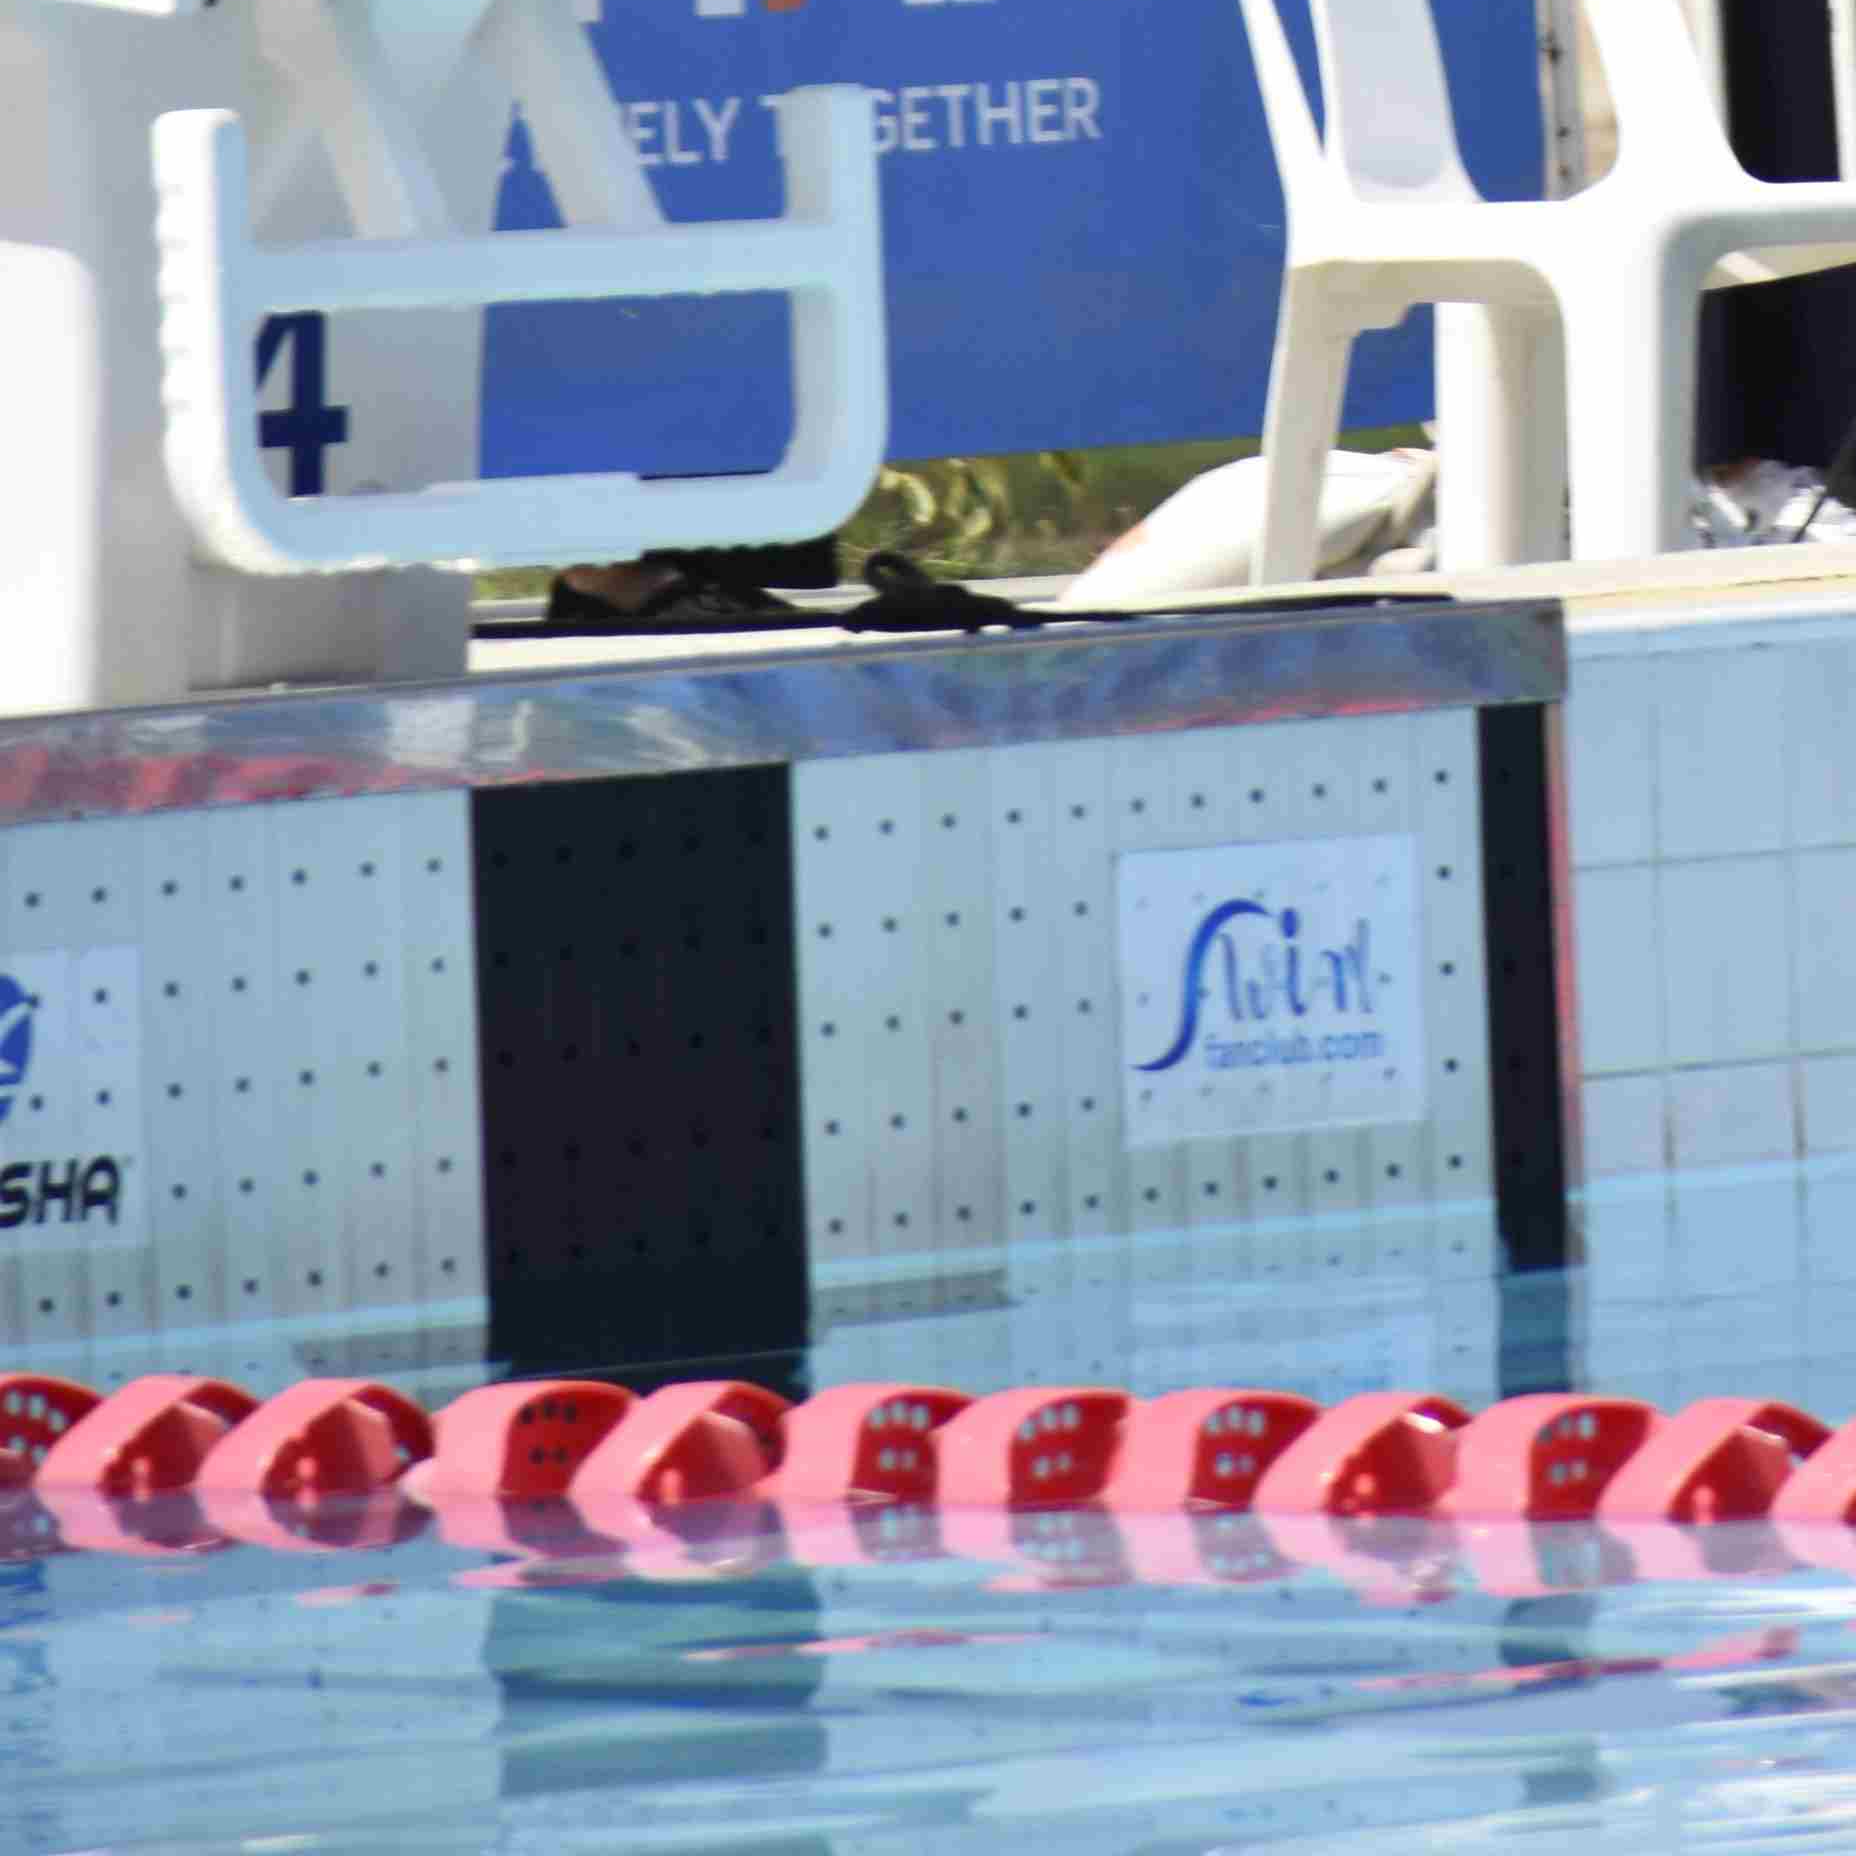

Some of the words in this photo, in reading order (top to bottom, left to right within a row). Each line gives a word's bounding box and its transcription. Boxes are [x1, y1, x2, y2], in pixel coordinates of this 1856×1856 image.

[622, 98, 743, 166] ELY
[757, 77, 1102, 158] TGETHER
[254, 308, 350, 498] 4
[0, 1154, 120, 1229] SHA
